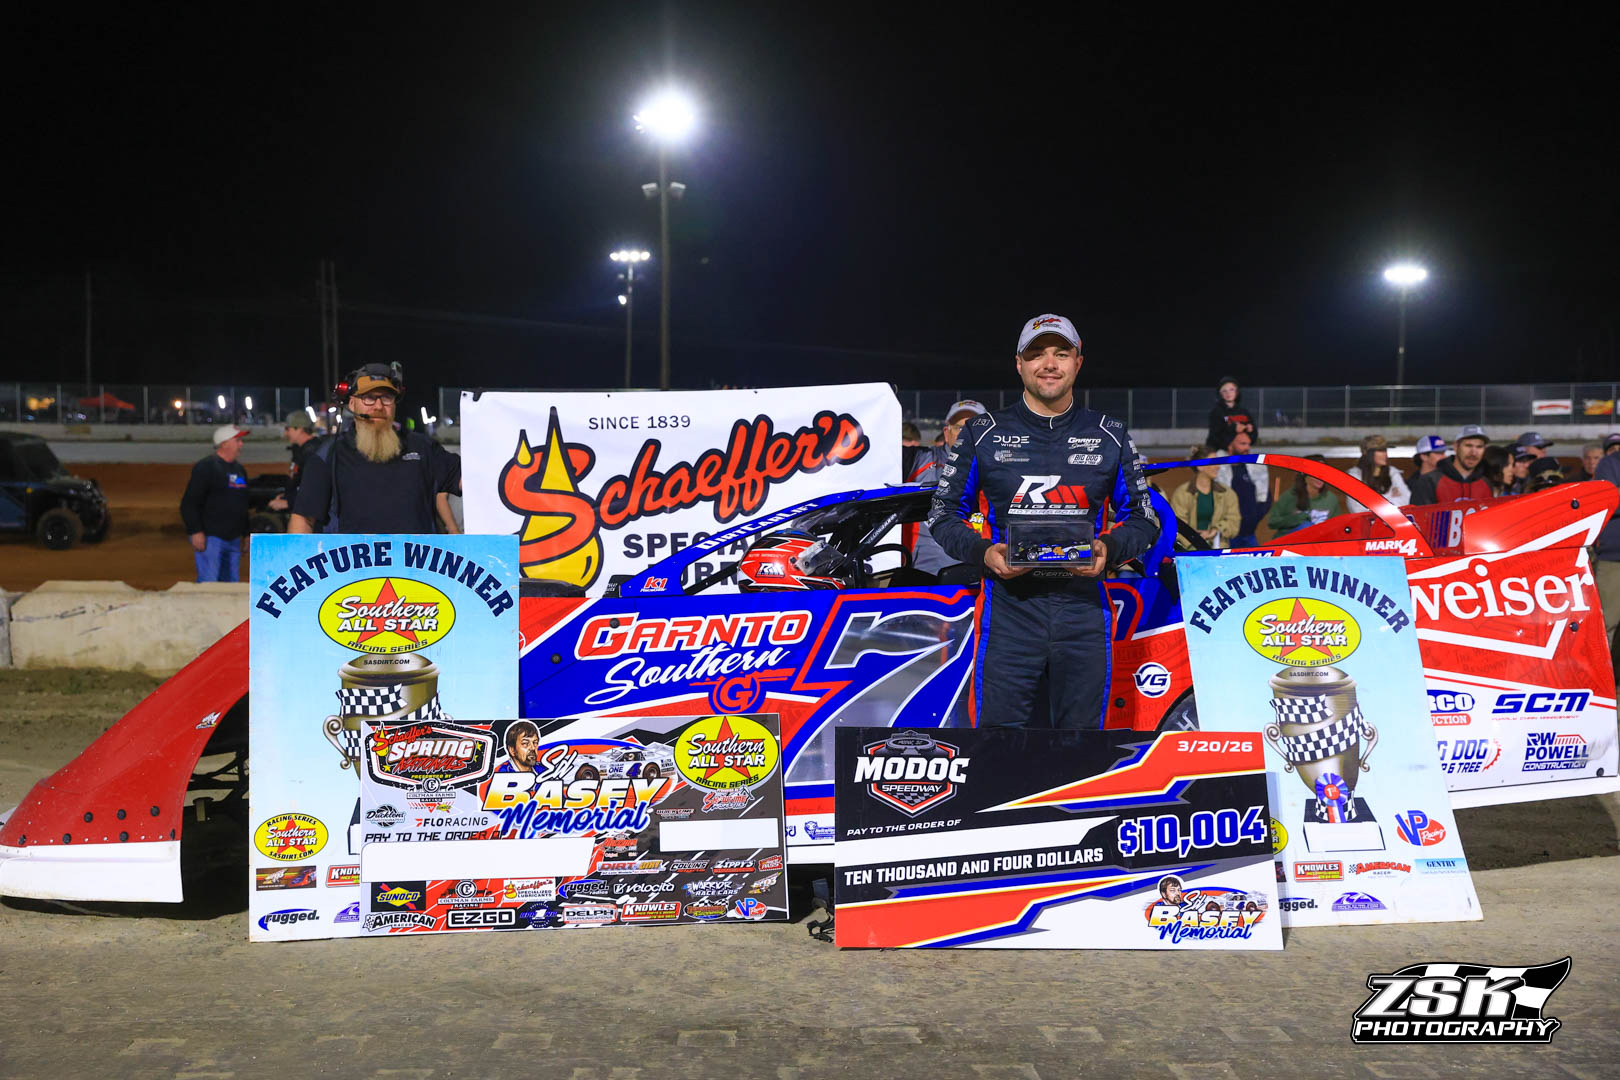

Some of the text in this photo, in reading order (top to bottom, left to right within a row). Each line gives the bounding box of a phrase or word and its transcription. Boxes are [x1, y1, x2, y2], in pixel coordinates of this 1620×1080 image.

[589, 415, 691, 430] SINCE 1839
[993, 435, 1030, 444] DUDE
[499, 411, 871, 568] Schaeffer's
[255, 541, 514, 619] FEATURE WINNER
[644, 576, 668, 589] K1
[338, 596, 439, 620] Southern
[1190, 565, 1411, 636] FEATURE WINNER
[338, 619, 439, 632] ALL STAR
[1259, 614, 1346, 634] Southern
[575, 613, 812, 660] GARNTO
[1262, 634, 1348, 646] ALL STAR
[347, 639, 429, 653] RACING SERIES
[363, 658, 411, 666] SASDIRT.COM
[1272, 654, 1342, 666] RACING SERIES
[585, 644, 790, 704] Southern
[1134, 673, 1169, 687] VG
[687, 733, 765, 756] Southern
[1526, 732, 1556, 746] RW
[388, 738, 475, 763] SPRING
[1177, 741, 1253, 757] 3/20/26
[1451, 739, 1489, 760] DOG
[1525, 745, 1590, 761] POWELL
[392, 756, 468, 774] NATIONALS
[539, 744, 576, 784] Ed
[689, 754, 766, 768] ALL STAR
[1457, 762, 1483, 773] TREE
[1524, 761, 1588, 771] CONSTRUCTION
[854, 756, 970, 784] MODOC
[696, 774, 759, 788] RACING SERIES
[881, 783, 942, 793] SPEEDWAY
[266, 815, 317, 828] RACING SERIES
[500, 799, 650, 839] Memorial
[265, 825, 317, 840] Southern
[847, 818, 962, 837] PAY TO THE ORDER OF
[1117, 805, 1268, 859] $10,004
[1394, 809, 1446, 847] VP Racing
[265, 837, 317, 847] ALL STAR
[365, 832, 391, 842] PAY
[396, 832, 413, 841] TO
[417, 831, 442, 841] THE
[445, 830, 489, 841] ORDER
[269, 849, 314, 860] SASDIRT.COM
[670, 862, 708, 871] COLLINS
[844, 848, 1104, 887] TEN THOUSAND AND FOUR DOLLARS
[1297, 863, 1340, 876] KNOWLES
[1356, 861, 1411, 876] AMERICAN
[563, 881, 609, 895] rugged.
[691, 880, 733, 891] WARRIOR
[717, 887, 739, 895] CARS
[379, 891, 420, 902] SUNOCO
[1180, 890, 1208, 913] Ed
[565, 910, 614, 918] DELPH
[623, 903, 678, 916] KNOWLES
[736, 898, 758, 917] VP
[265, 910, 321, 925] rugged.
[372, 913, 437, 930] AMERICAN
[1159, 921, 1252, 944] Memorial
